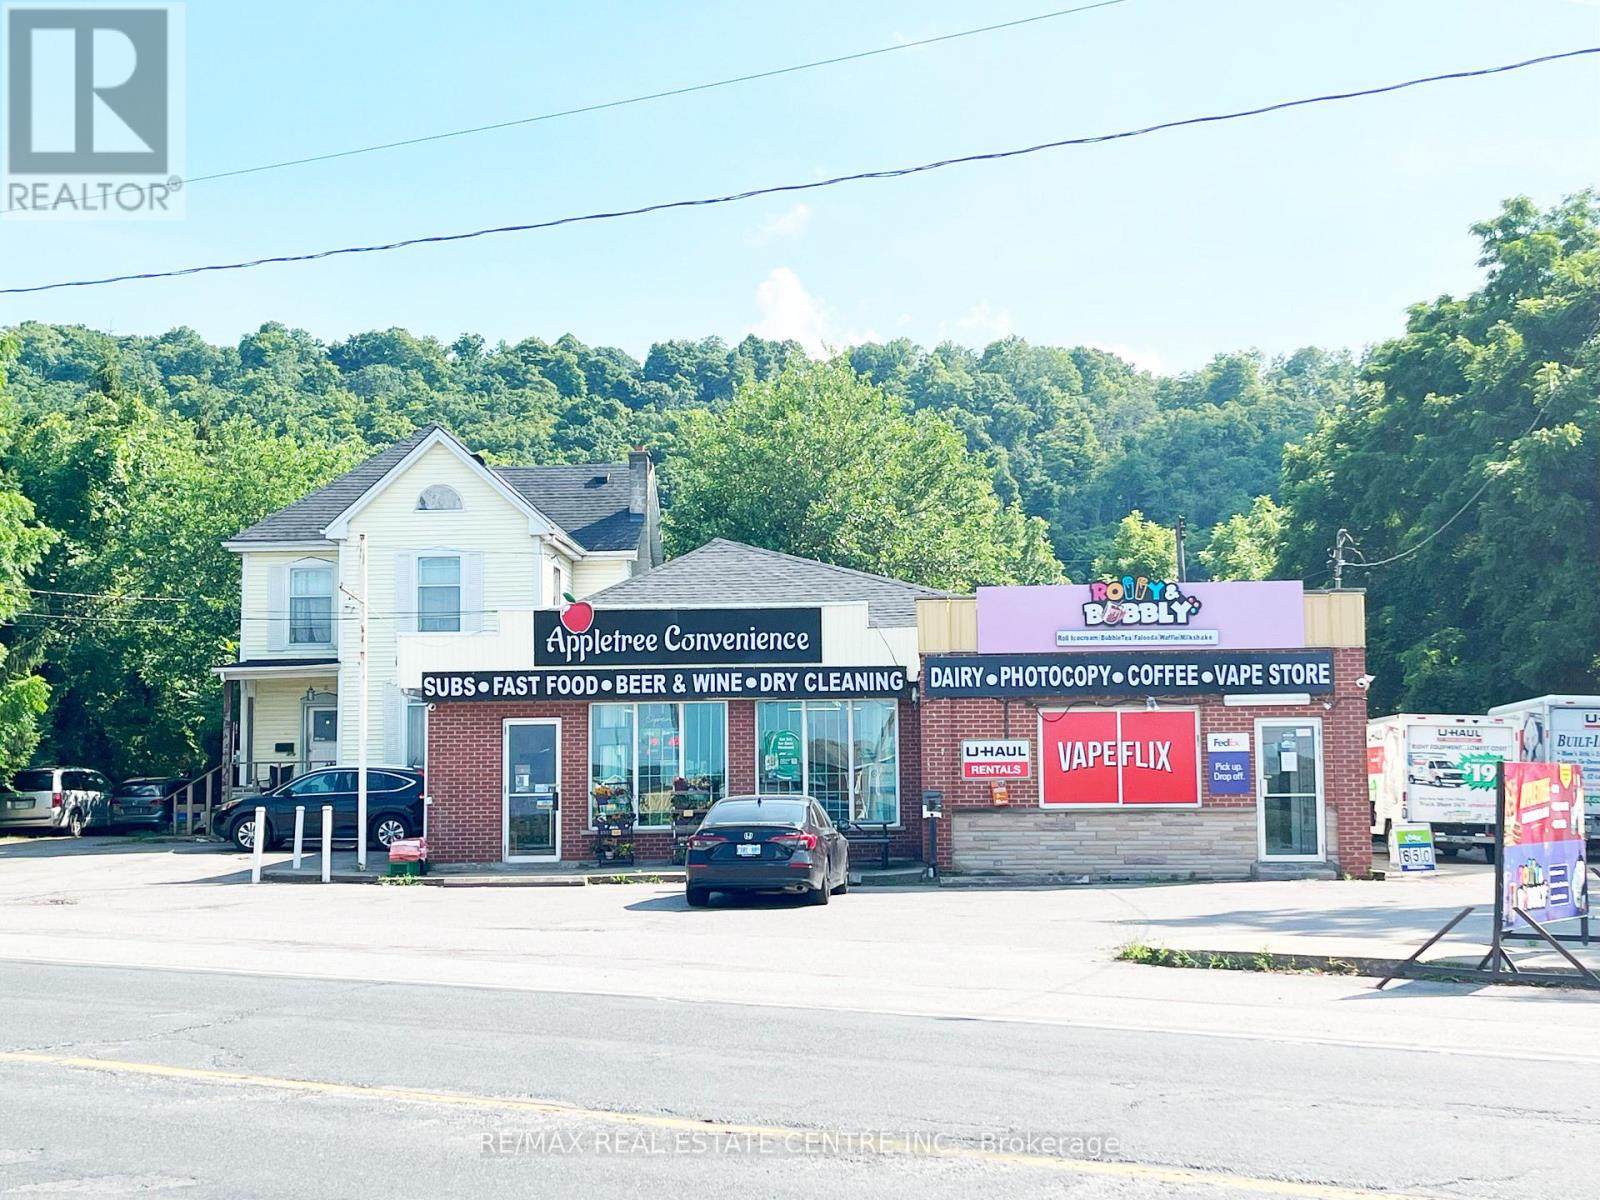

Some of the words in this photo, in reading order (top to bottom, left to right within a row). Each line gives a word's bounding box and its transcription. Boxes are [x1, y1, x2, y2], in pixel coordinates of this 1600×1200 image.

[1165, 584, 1180, 600] &
[546, 626, 658, 662] Appletree
[664, 624, 809, 651] Convenience
[930, 667, 984, 688] DAIRY
[1000, 665, 1111, 687] PHOTOCOPY
[1128, 664, 1199, 686] COFFEE
[1214, 664, 1263, 685] VAPE
[1269, 663, 1330, 685] STORE
[424, 677, 476, 697] SUBS
[493, 676, 540, 696] FAST
[546, 675, 599, 695] FOOD
[616, 674, 666, 694] BEER
[672, 674, 686, 693] &
[692, 673, 743, 692] WINE
[760, 672, 799, 692] DRY
[804, 671, 904, 692] CLEANING
[1557, 734, 1600, 748] BUILT-I
[966, 746, 1026, 757] U-HAUL
[971, 765, 1021, 775] RENTALS
[1215, 762, 1231, 771] Pick
[1213, 772, 1232, 782] Drop
[1233, 772, 1246, 780] off.
